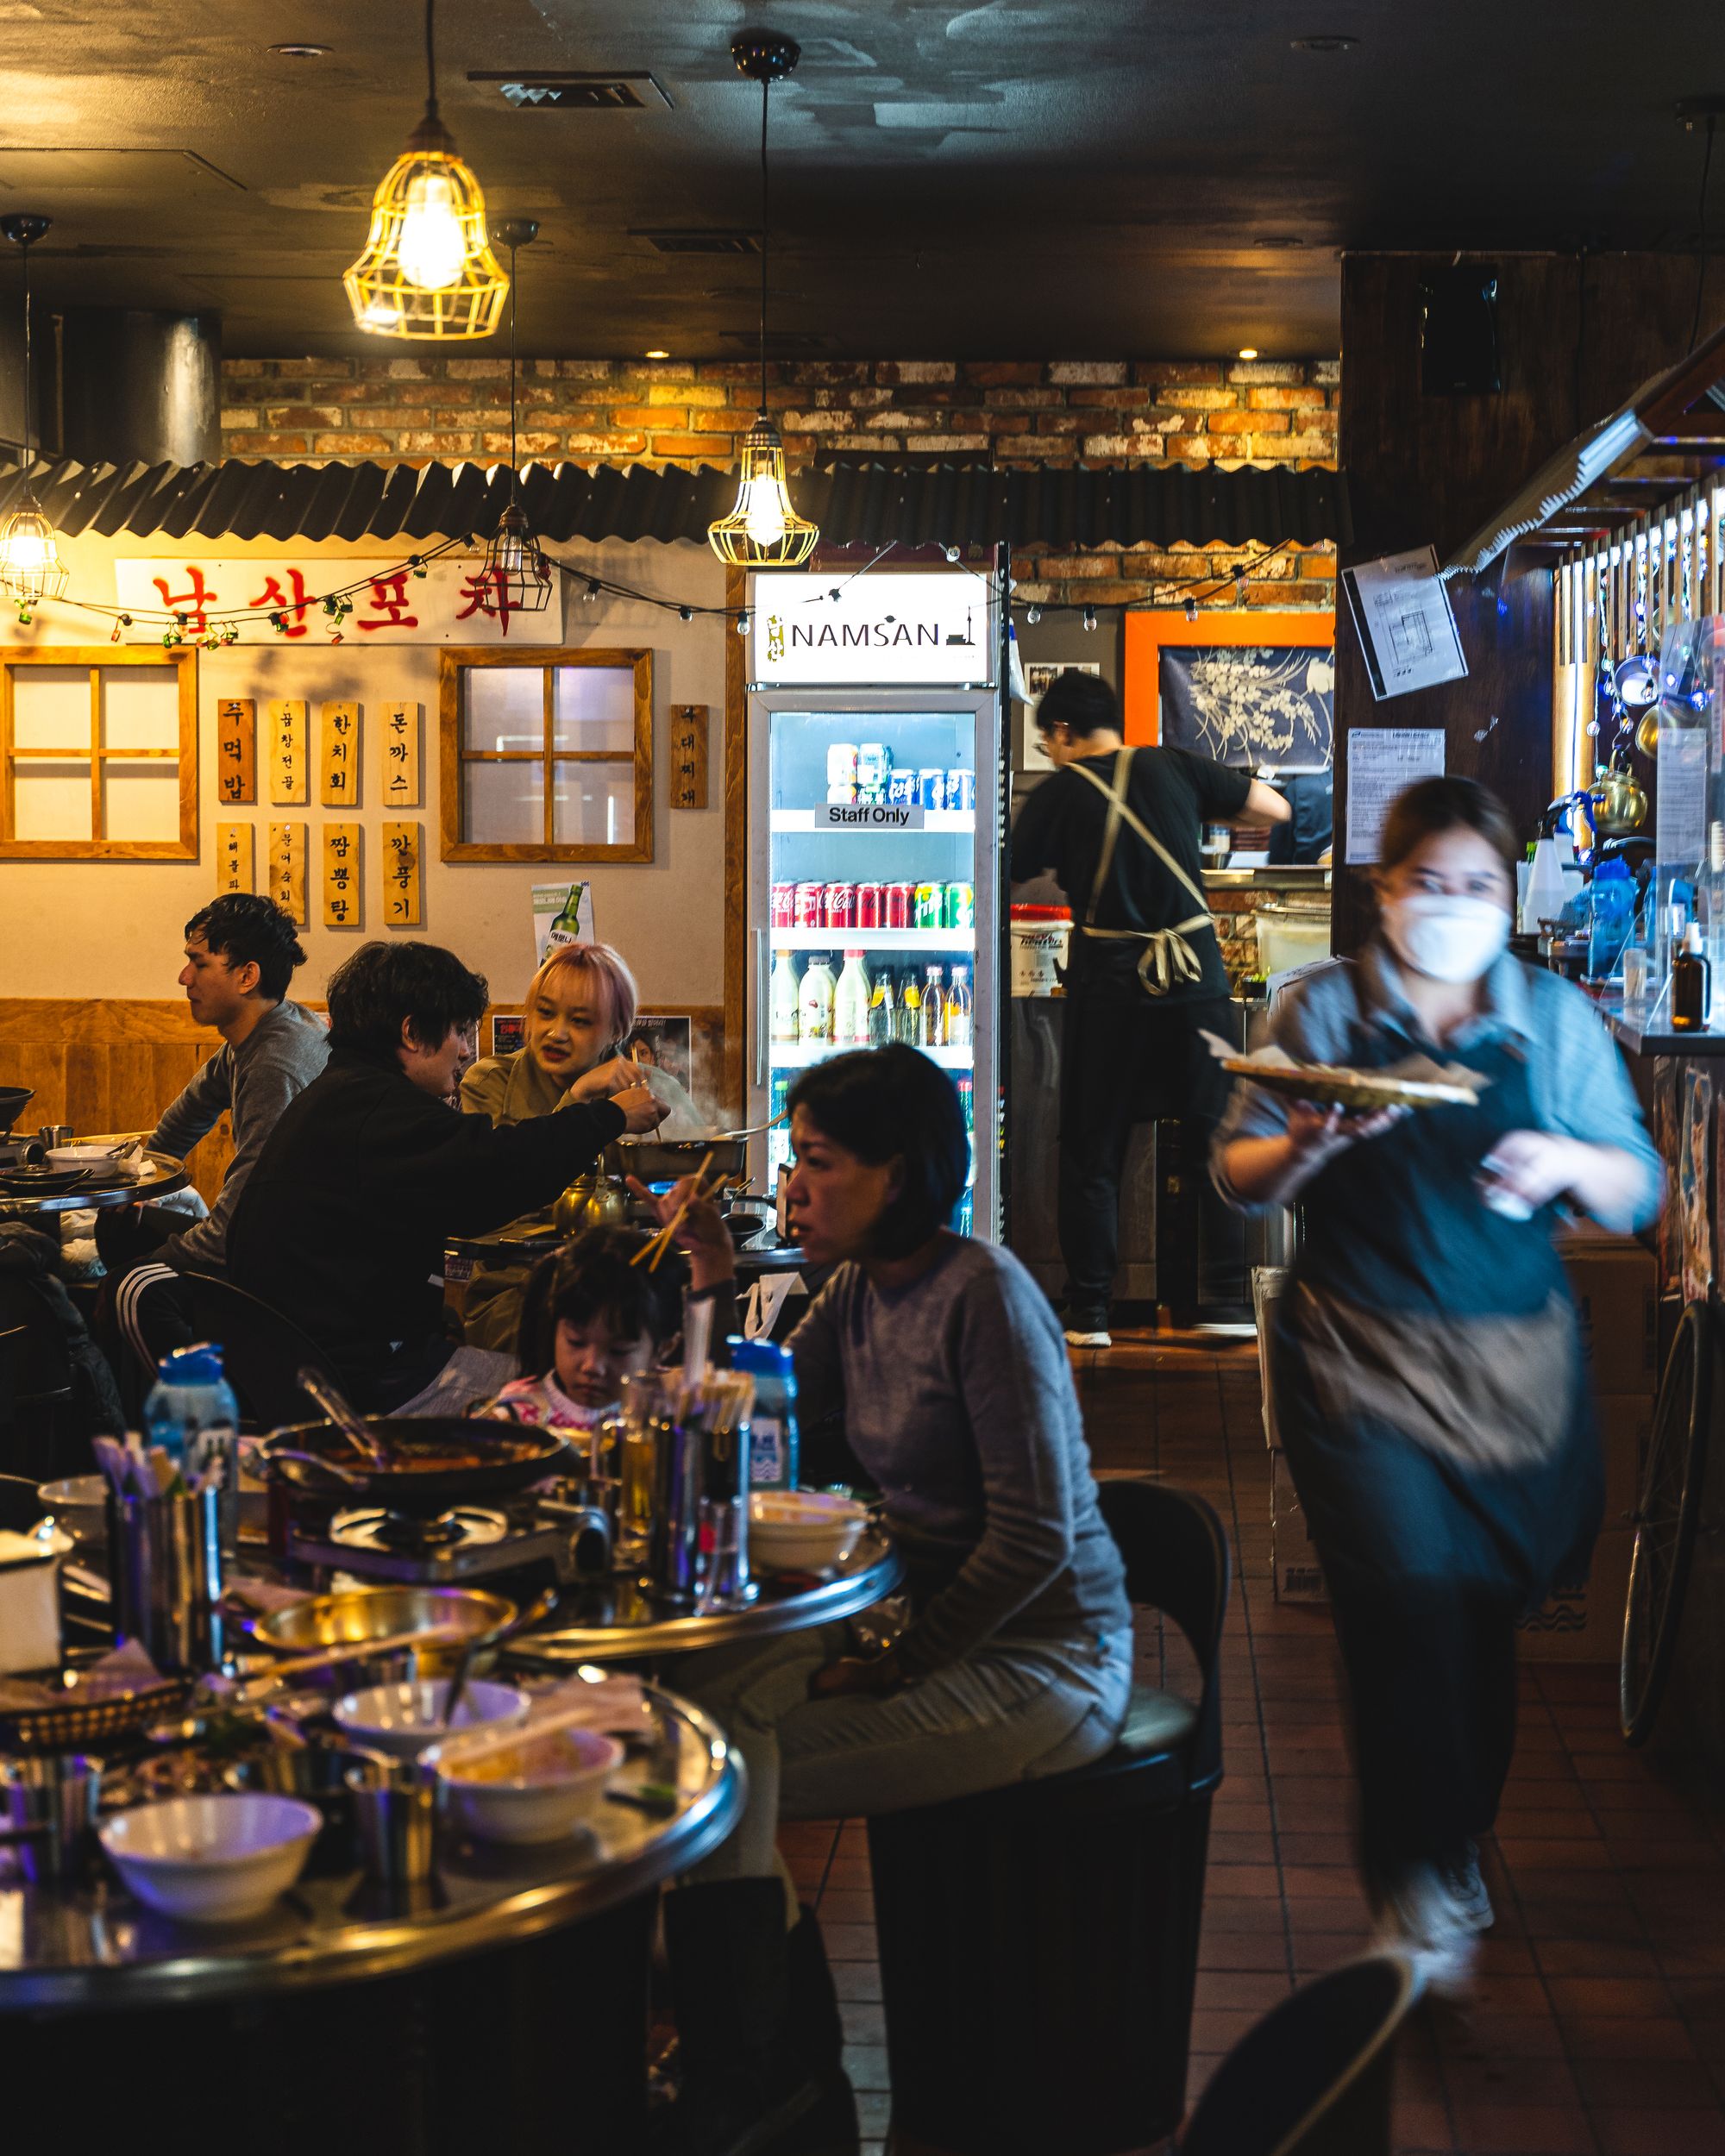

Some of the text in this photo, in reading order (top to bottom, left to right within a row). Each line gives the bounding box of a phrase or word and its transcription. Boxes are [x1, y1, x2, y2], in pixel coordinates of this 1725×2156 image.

[792, 623, 938, 647] NAMSAN
[223, 703, 245, 799] 주먹밥
[330, 715, 350, 790] 한치회
[390, 712, 408, 791] 돈까스
[829, 807, 909, 825] Staff Only
[329, 836, 349, 922] 짬뽕탕
[391, 835, 411, 918] 깐풍기
